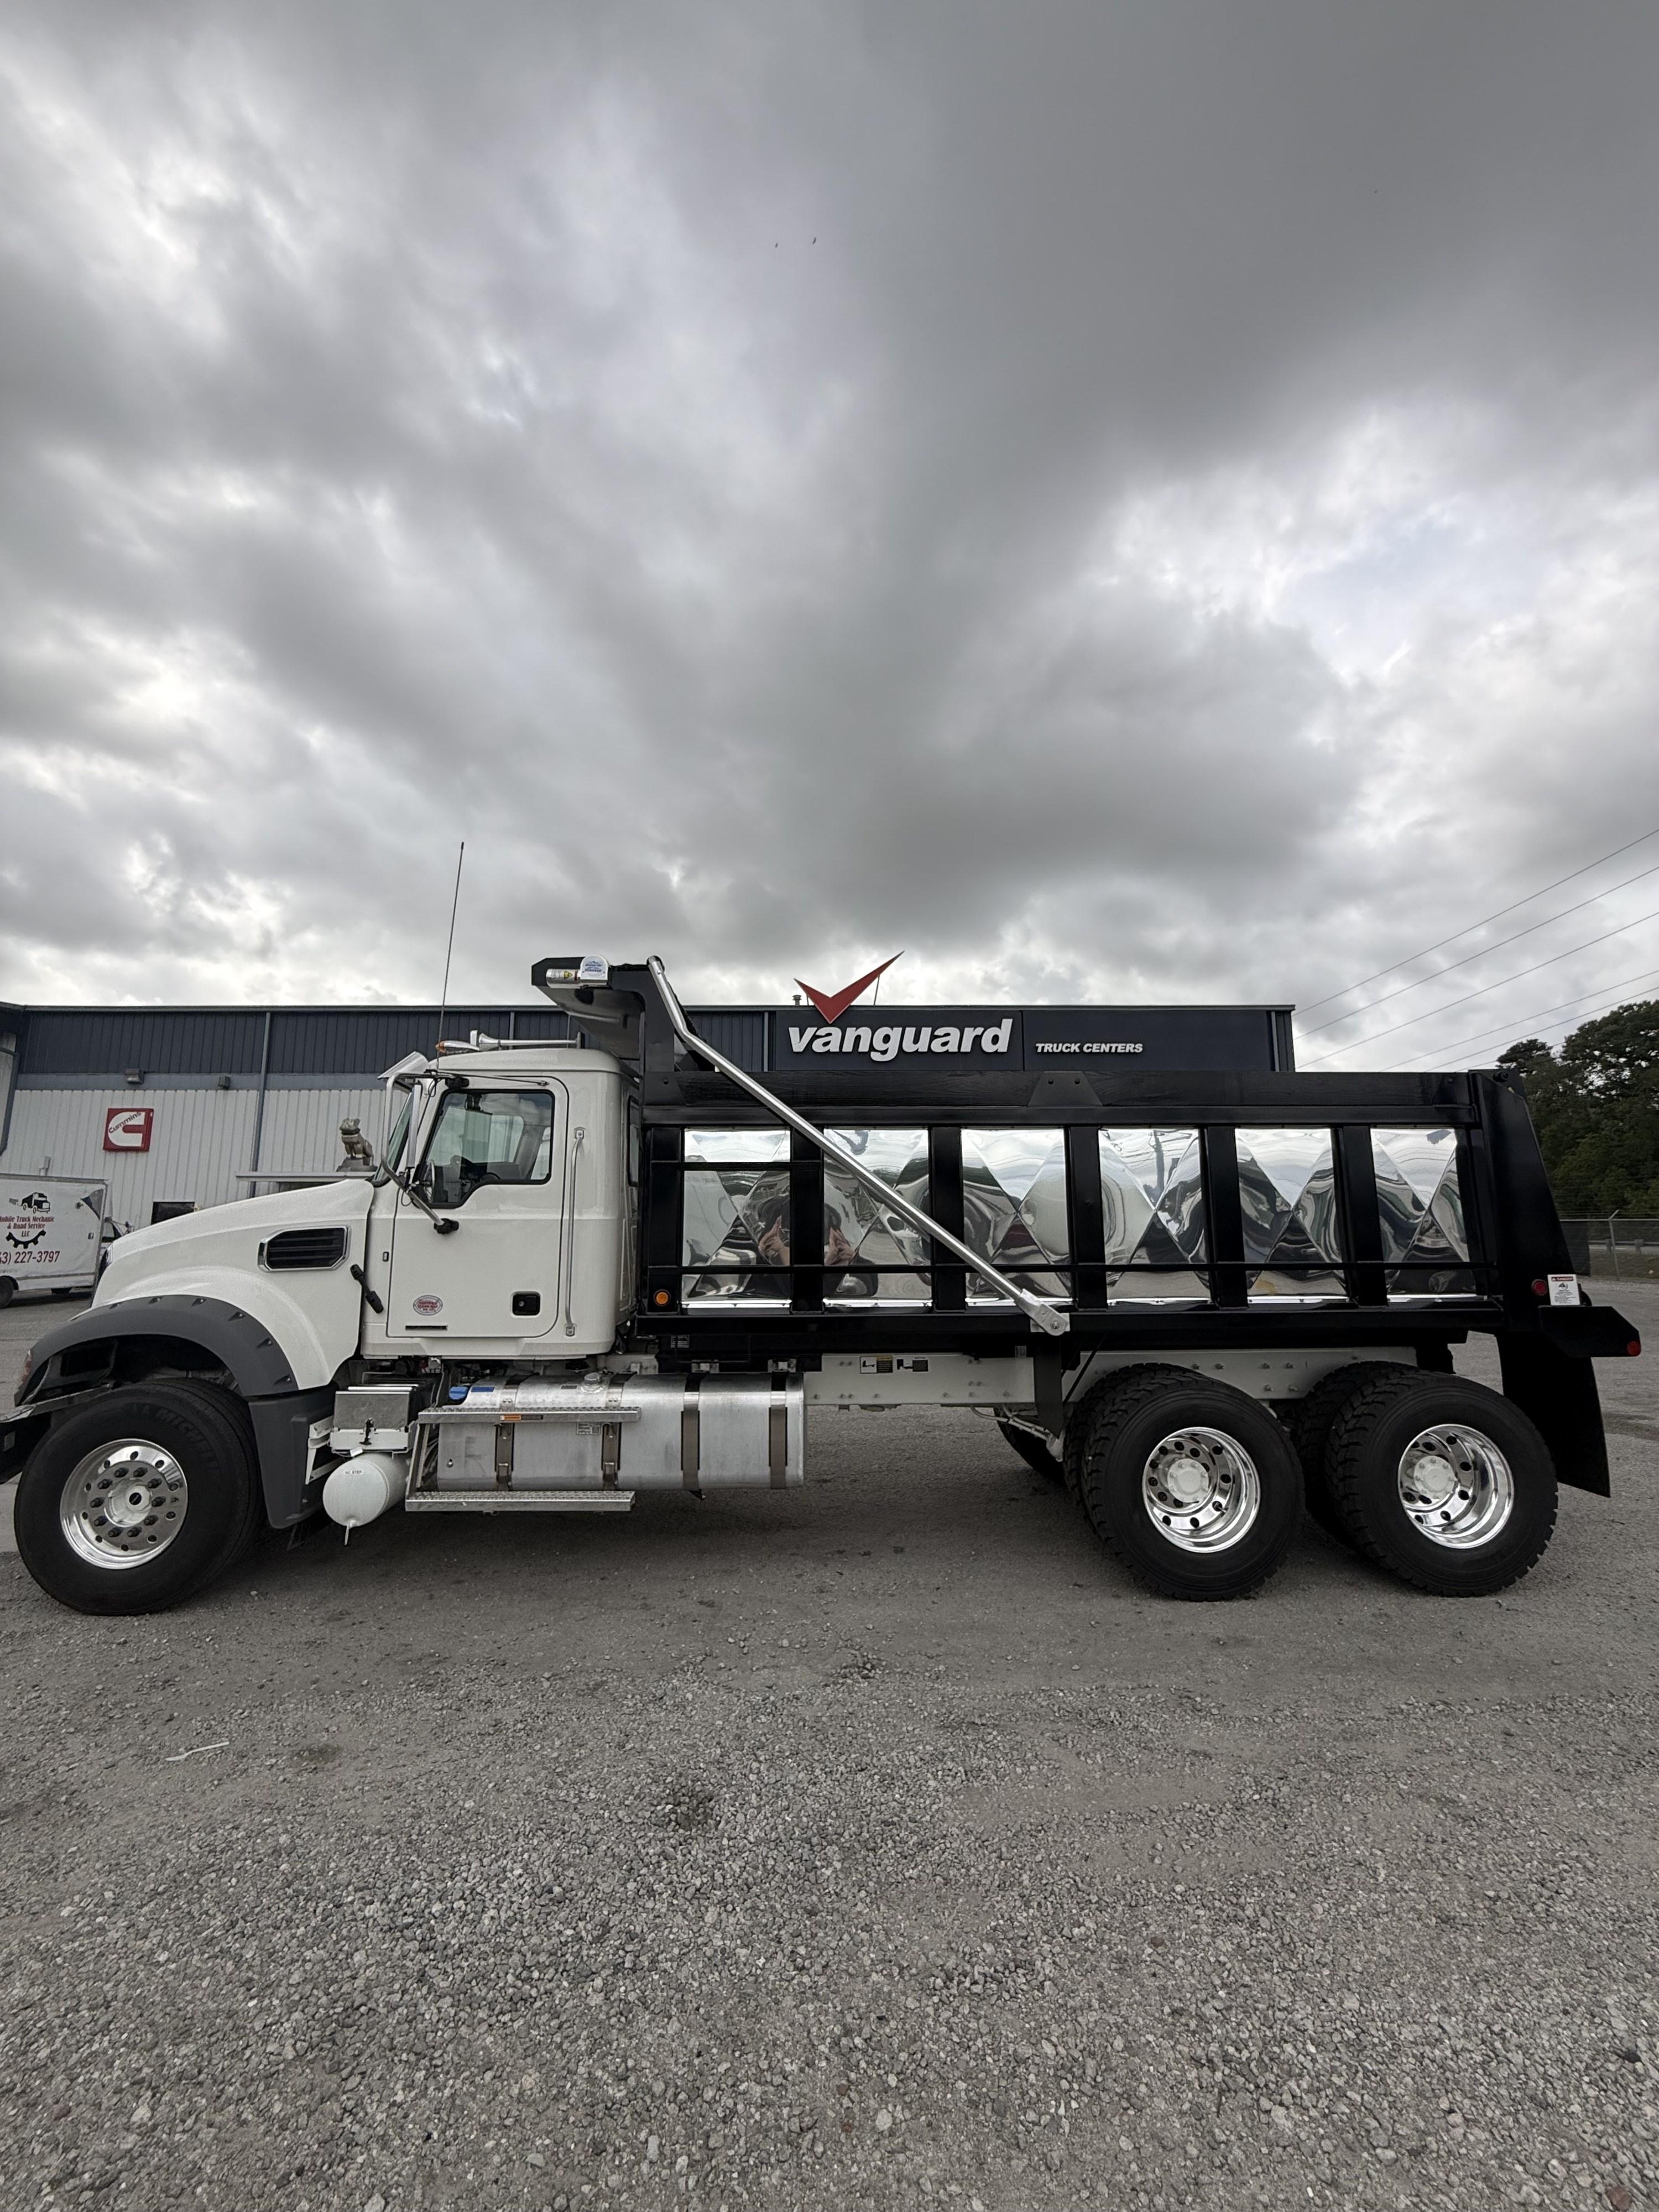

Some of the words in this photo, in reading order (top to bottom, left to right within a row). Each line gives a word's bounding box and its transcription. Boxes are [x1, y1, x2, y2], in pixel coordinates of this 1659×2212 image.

[788, 1019, 1013, 1062] vanguard
[1035, 1043, 1081, 1053] TRUCK
[1083, 1043, 1143, 1053] CENTERS
[108, 1112, 142, 1134] Cummins
[14, 1250, 60, 1264] 227-3797
[154, 1407, 220, 1477] MICHELI
